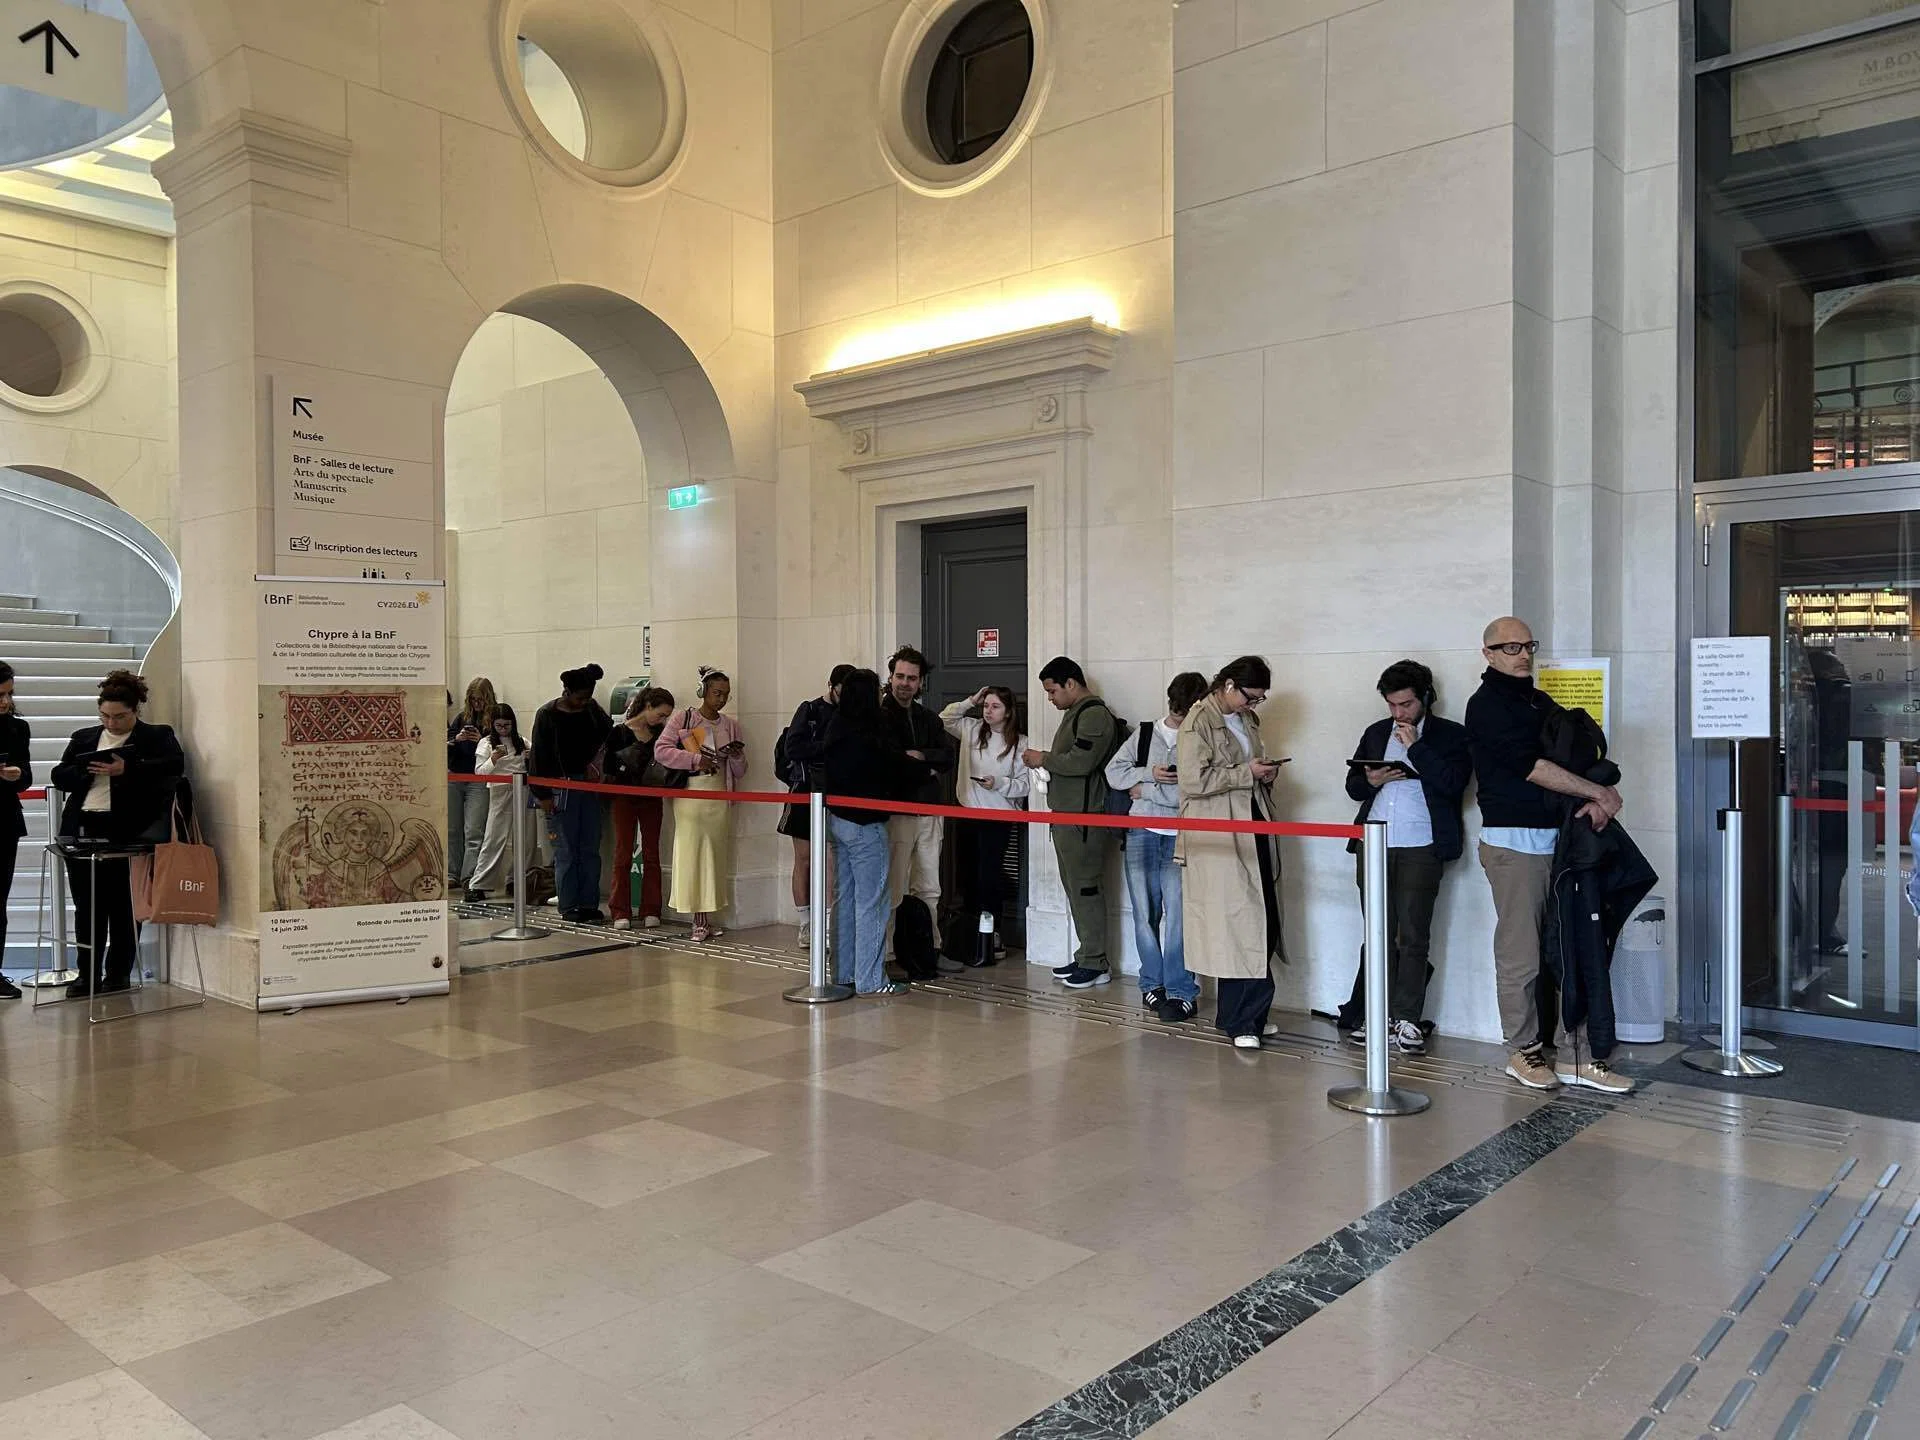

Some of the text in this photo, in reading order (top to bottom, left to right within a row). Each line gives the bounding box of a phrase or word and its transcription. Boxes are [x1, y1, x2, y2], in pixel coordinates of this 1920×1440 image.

[292, 430, 324, 442] Musée
[293, 455, 312, 464] BnF
[320, 457, 347, 469] Salles
[349, 462, 360, 471] de
[362, 463, 394, 475] lecture
[294, 467, 374, 484] Arts du spectacle
[294, 479, 347, 493] Manuscrits
[294, 492, 335, 504] Musique
[314, 541, 418, 558] Inscription des lecteurs
[377, 601, 419, 609] CY2026.EU
[308, 629, 349, 641] Chypre
[361, 630, 371, 639] la
[374, 630, 397, 640] BnF
